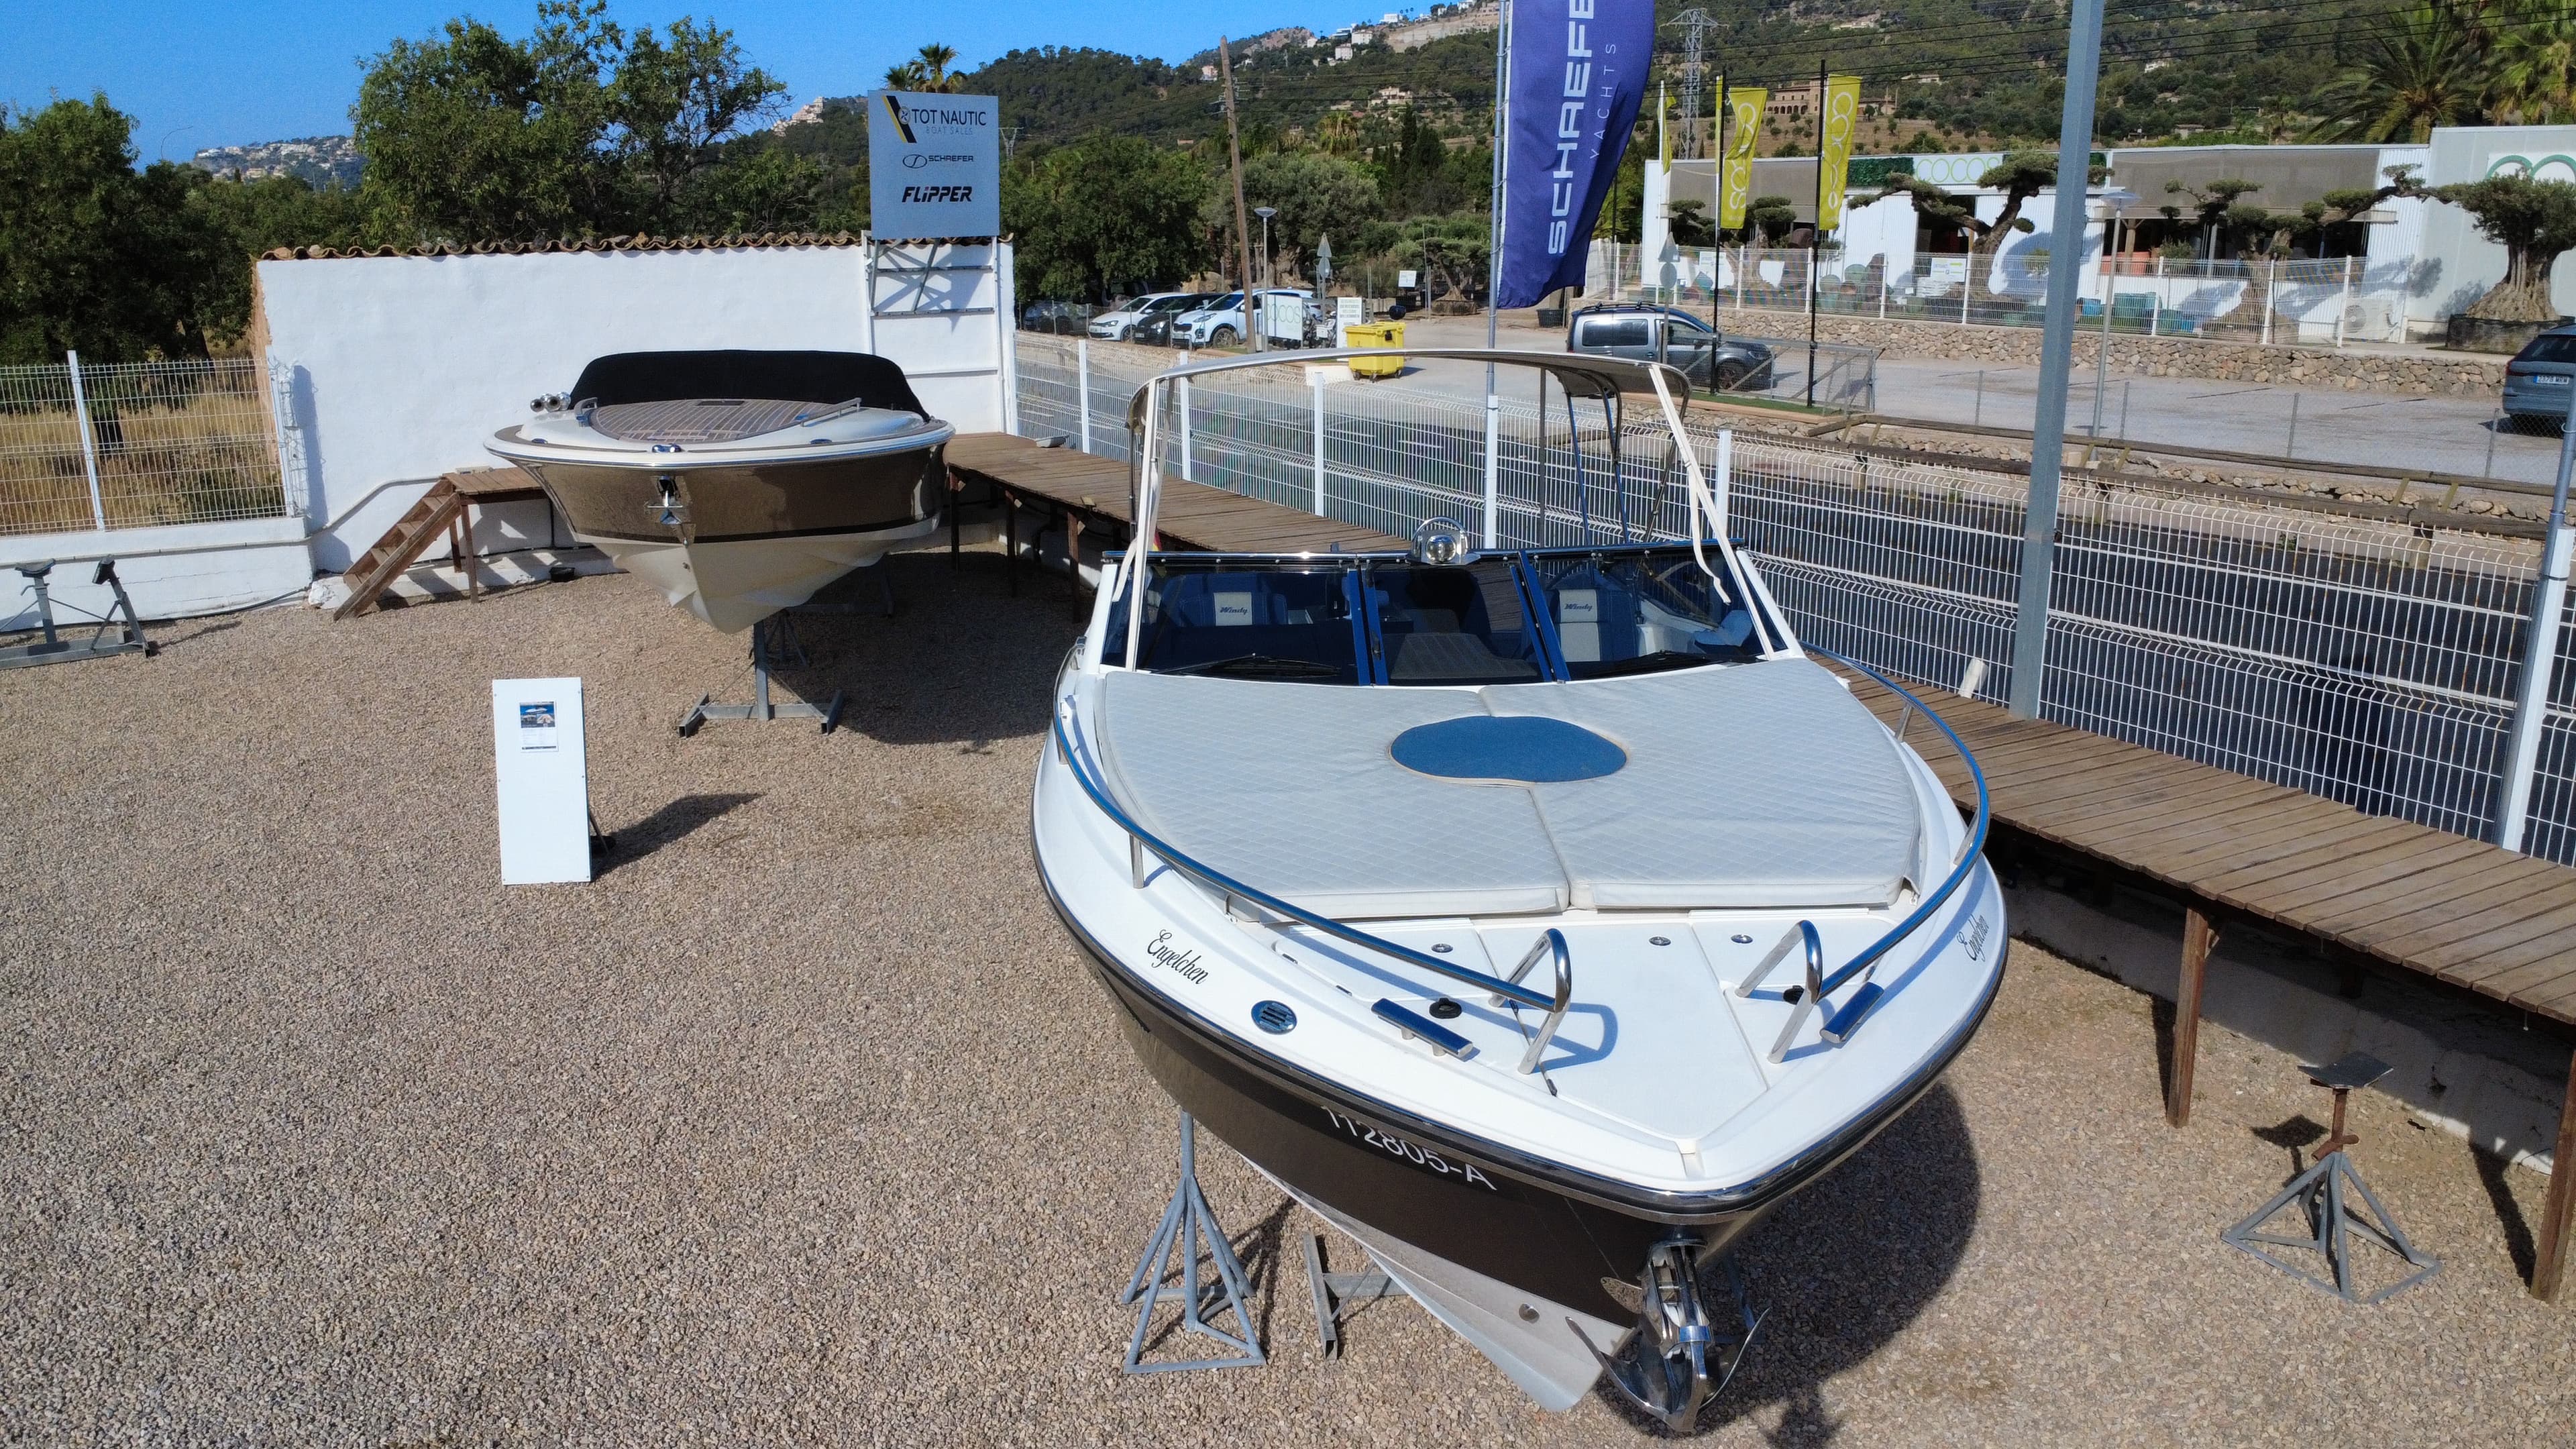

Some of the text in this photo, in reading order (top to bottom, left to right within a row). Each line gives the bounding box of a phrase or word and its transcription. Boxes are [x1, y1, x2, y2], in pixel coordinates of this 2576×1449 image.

[1590, 44, 1616, 159] YACHTS
[912, 109, 987, 126] TOT NAUTIC
[926, 125, 973, 135] BOAT SALES
[1220, 606, 1248, 615] Windy
[1564, 604, 1593, 612] Windy
[1147, 928, 1209, 985] Engelchen
[1320, 1106, 1497, 1191] 112805-A
